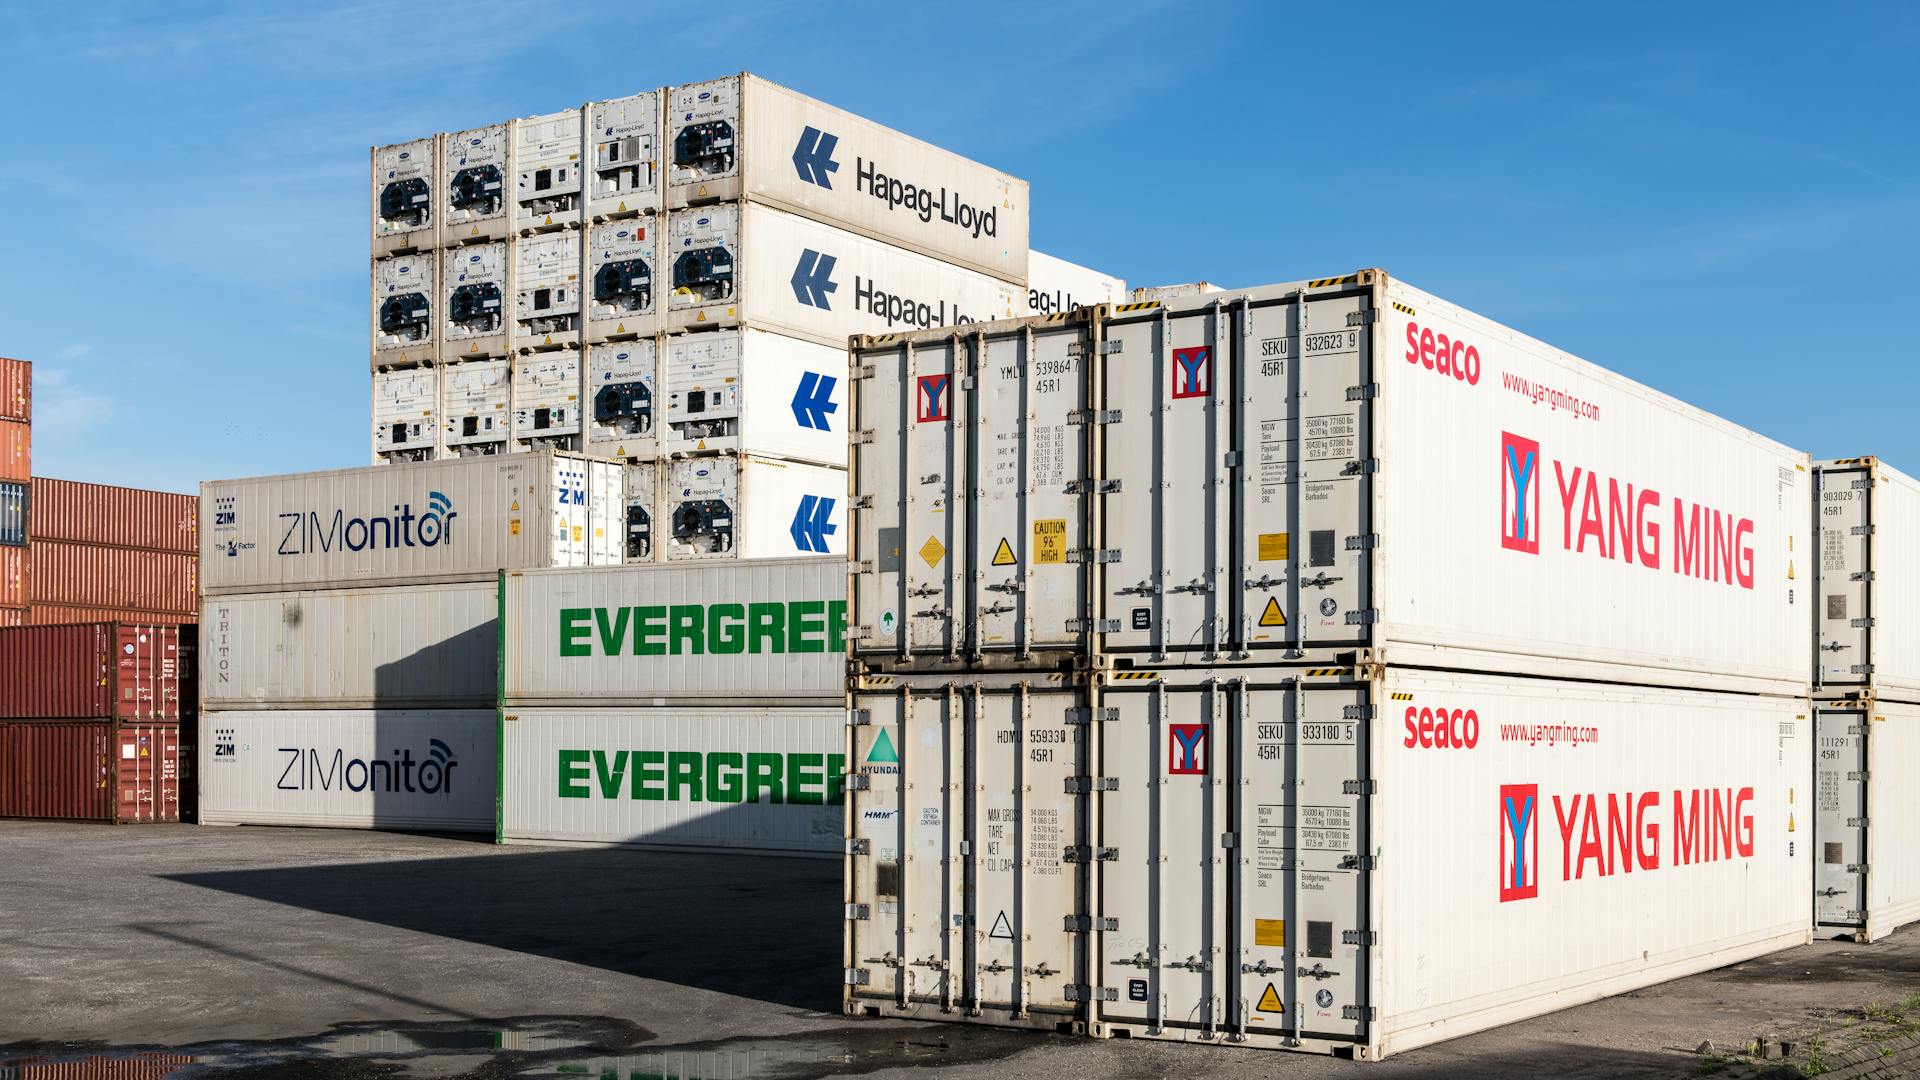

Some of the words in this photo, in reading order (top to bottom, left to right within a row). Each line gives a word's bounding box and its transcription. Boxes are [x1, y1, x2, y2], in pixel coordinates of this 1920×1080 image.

[856, 157, 996, 238] Hapag-Lloyd
[1262, 340, 1287, 356] SEKU
[1306, 334, 1342, 352] 932623
[1349, 332, 1356, 348] 9
[1406, 322, 1480, 386] seaco
[1000, 365, 1024, 380] YMLU
[1036, 360, 1070, 376] 539864
[1074, 358, 1080, 372] 7
[1261, 361, 1284, 376] 45R1
[1036, 378, 1060, 393] 45R1
[1502, 371, 1600, 422] www.yangming.com
[1824, 491, 1852, 501] 903029
[1857, 491, 1862, 500] 7
[216, 512, 235, 524] ZIM
[1824, 506, 1842, 516] 45R1
[278, 503, 457, 556] ZIMonitor
[1034, 521, 1066, 534] CAUTION
[1553, 460, 1660, 570] YANG
[1674, 497, 1754, 590] MING
[1041, 549, 1058, 562] HIGH
[218, 608, 229, 683] TRITON
[1258, 725, 1283, 740] SEKU
[1303, 725, 1340, 740] 933180
[1346, 725, 1352, 740] 5
[1404, 706, 1479, 749] seaco
[1501, 721, 1598, 747] www.yangming.com
[997, 730, 1022, 744] HDMU
[1030, 730, 1066, 743] 559330
[215, 744, 234, 756] ZIM
[1030, 749, 1053, 762] 45R1
[1258, 746, 1280, 760] 45R1
[1821, 750, 1840, 759] 45R1
[277, 748, 458, 794] ZIMonitor
[988, 809, 1000, 822] MAX
[1003, 809, 1020, 822] GROSS
[988, 826, 1003, 838] TARE
[1552, 792, 1659, 881] YANG
[1674, 787, 1754, 866] MING
[988, 842, 999, 855] NET
